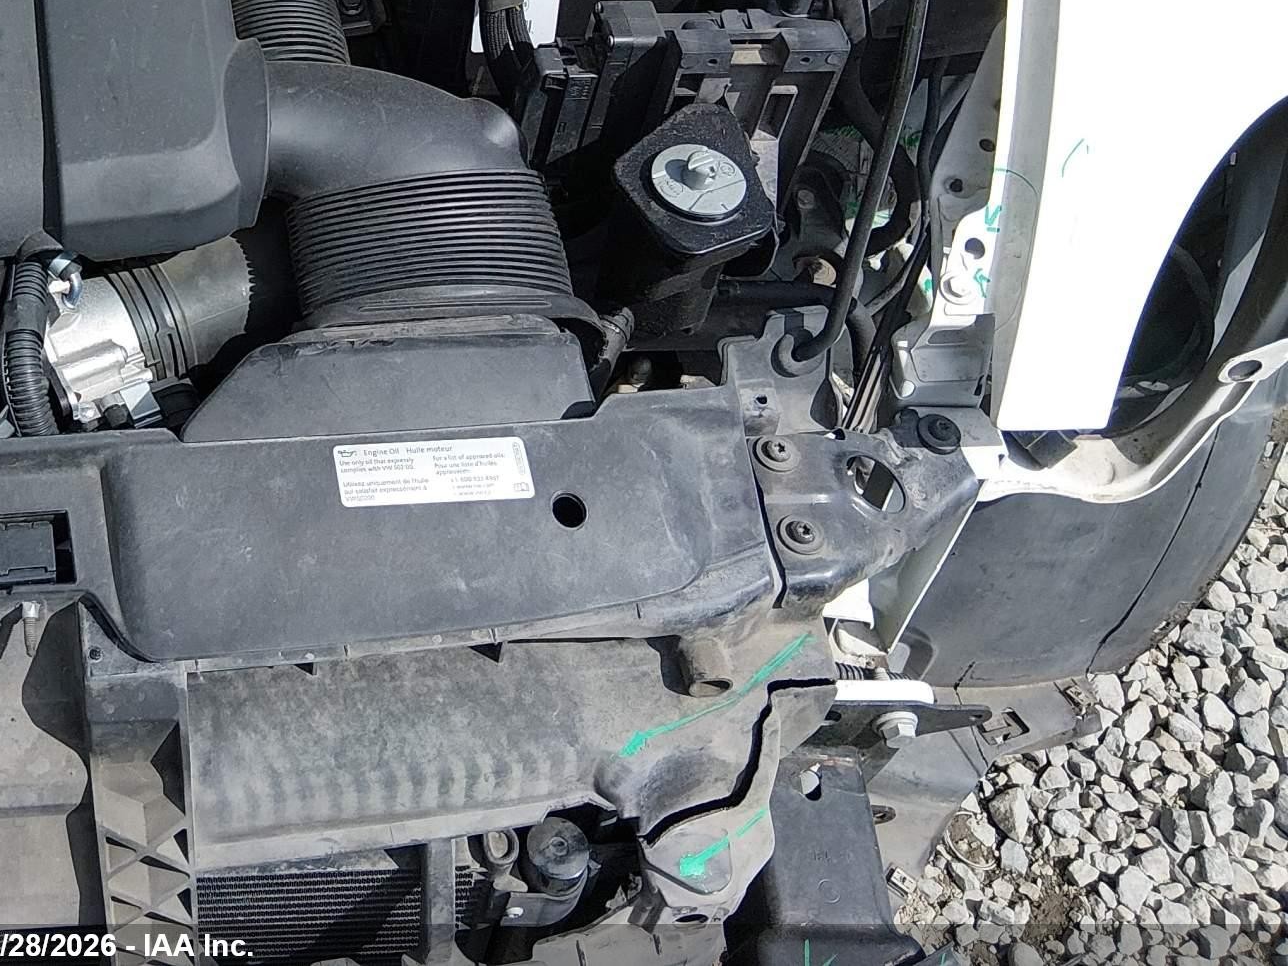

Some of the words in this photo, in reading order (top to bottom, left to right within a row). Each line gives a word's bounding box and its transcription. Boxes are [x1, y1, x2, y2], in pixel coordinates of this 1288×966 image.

[364, 449, 388, 457] Engine
[388, 448, 399, 456] Oil
[406, 447, 424, 455] Huile
